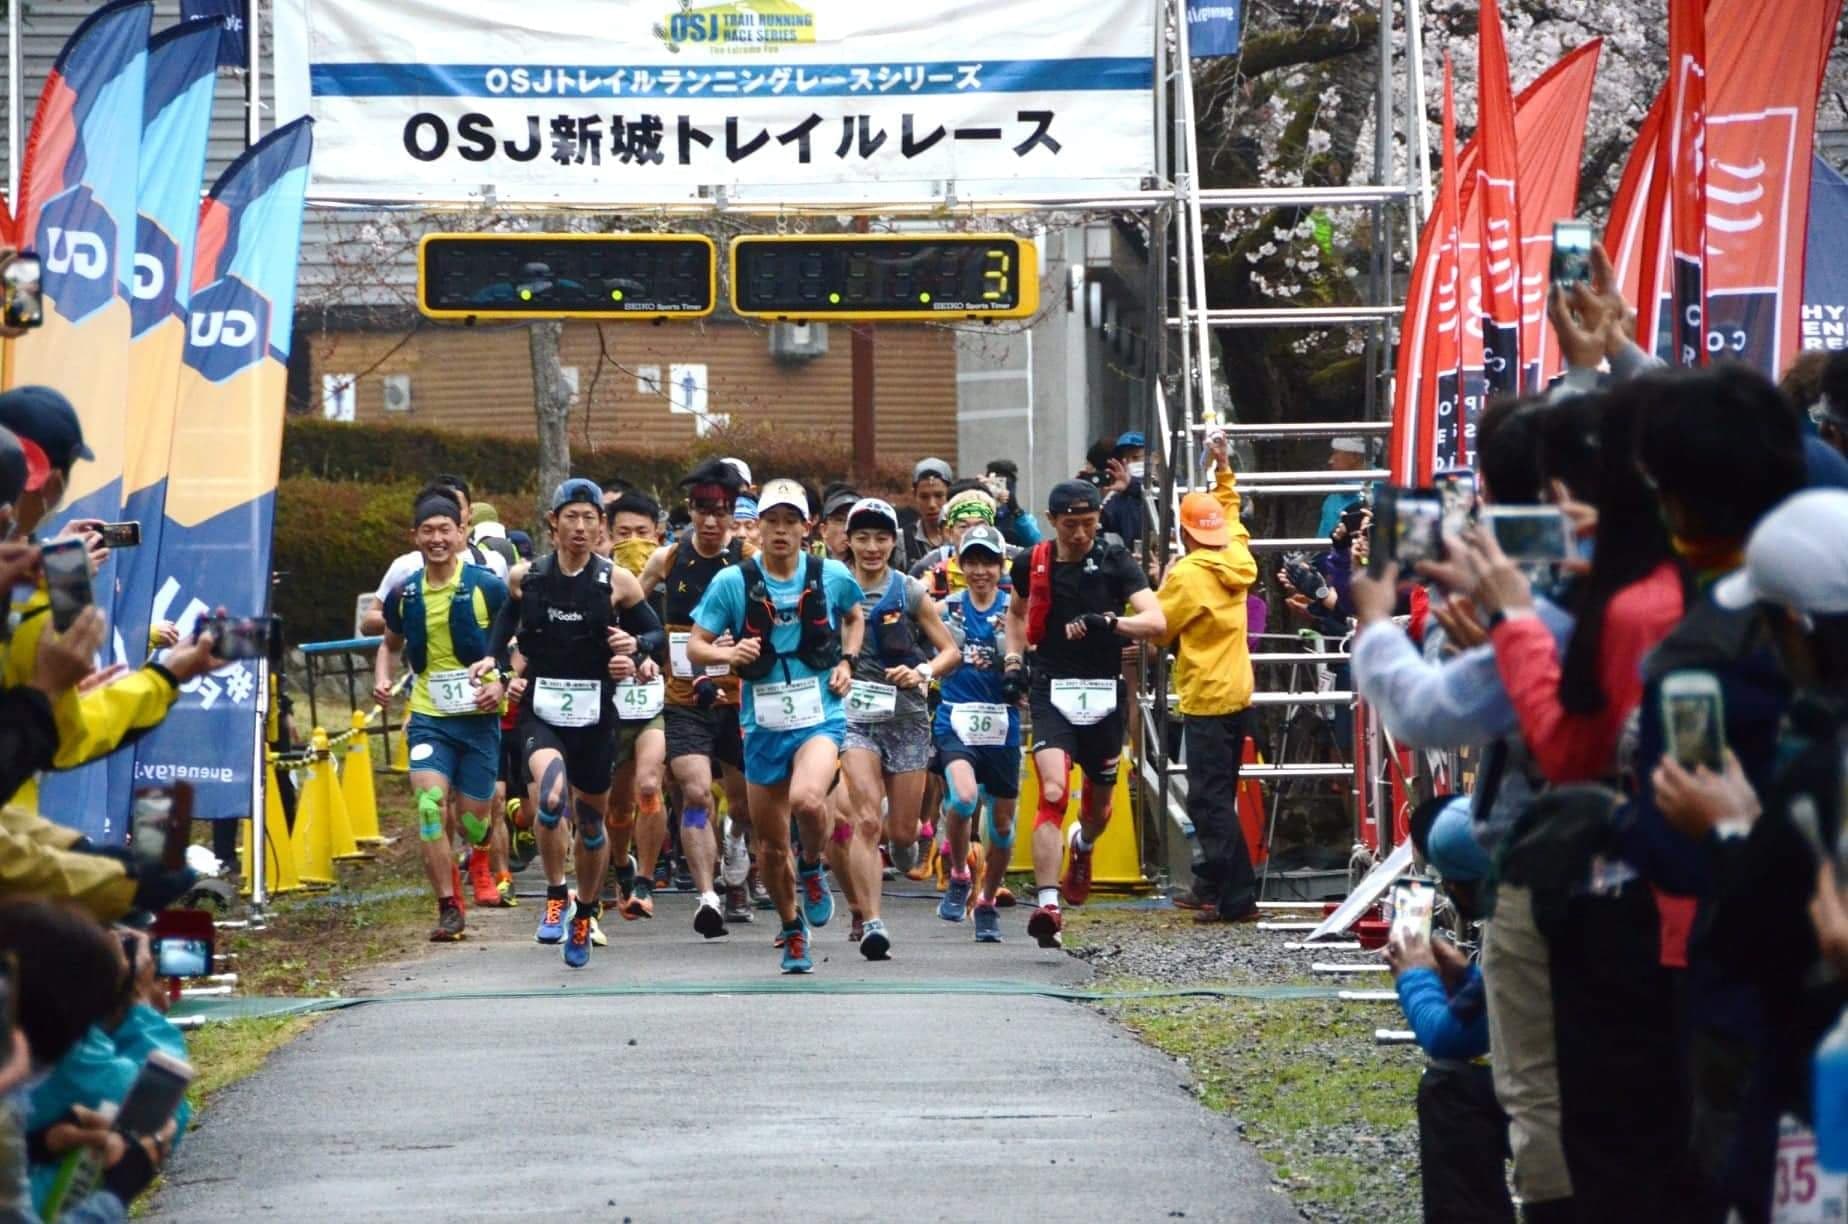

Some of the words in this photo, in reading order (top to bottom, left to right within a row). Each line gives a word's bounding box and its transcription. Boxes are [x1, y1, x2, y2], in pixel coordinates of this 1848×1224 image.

[670, 13, 719, 43] OSJ
[723, 14, 755, 27] TRAIL
[758, 14, 813, 27] RUNNING
[723, 30, 753, 42] RACE
[757, 30, 798, 42] SERIES
[485, 63, 983, 95] OSJトレイルランニングレースシリーズ
[403, 110, 1064, 167] OSJ新城トレイルレース
[982, 250, 1010, 299] 3
[1801, 304, 1848, 321] HY
[1801, 321, 1848, 336] EN
[441, 682, 464, 701] 31
[624, 688, 648, 705] 45
[560, 692, 574, 712] 2
[781, 695, 795, 715] 3
[1077, 692, 1088, 711] 1
[968, 714, 993, 733] 36
